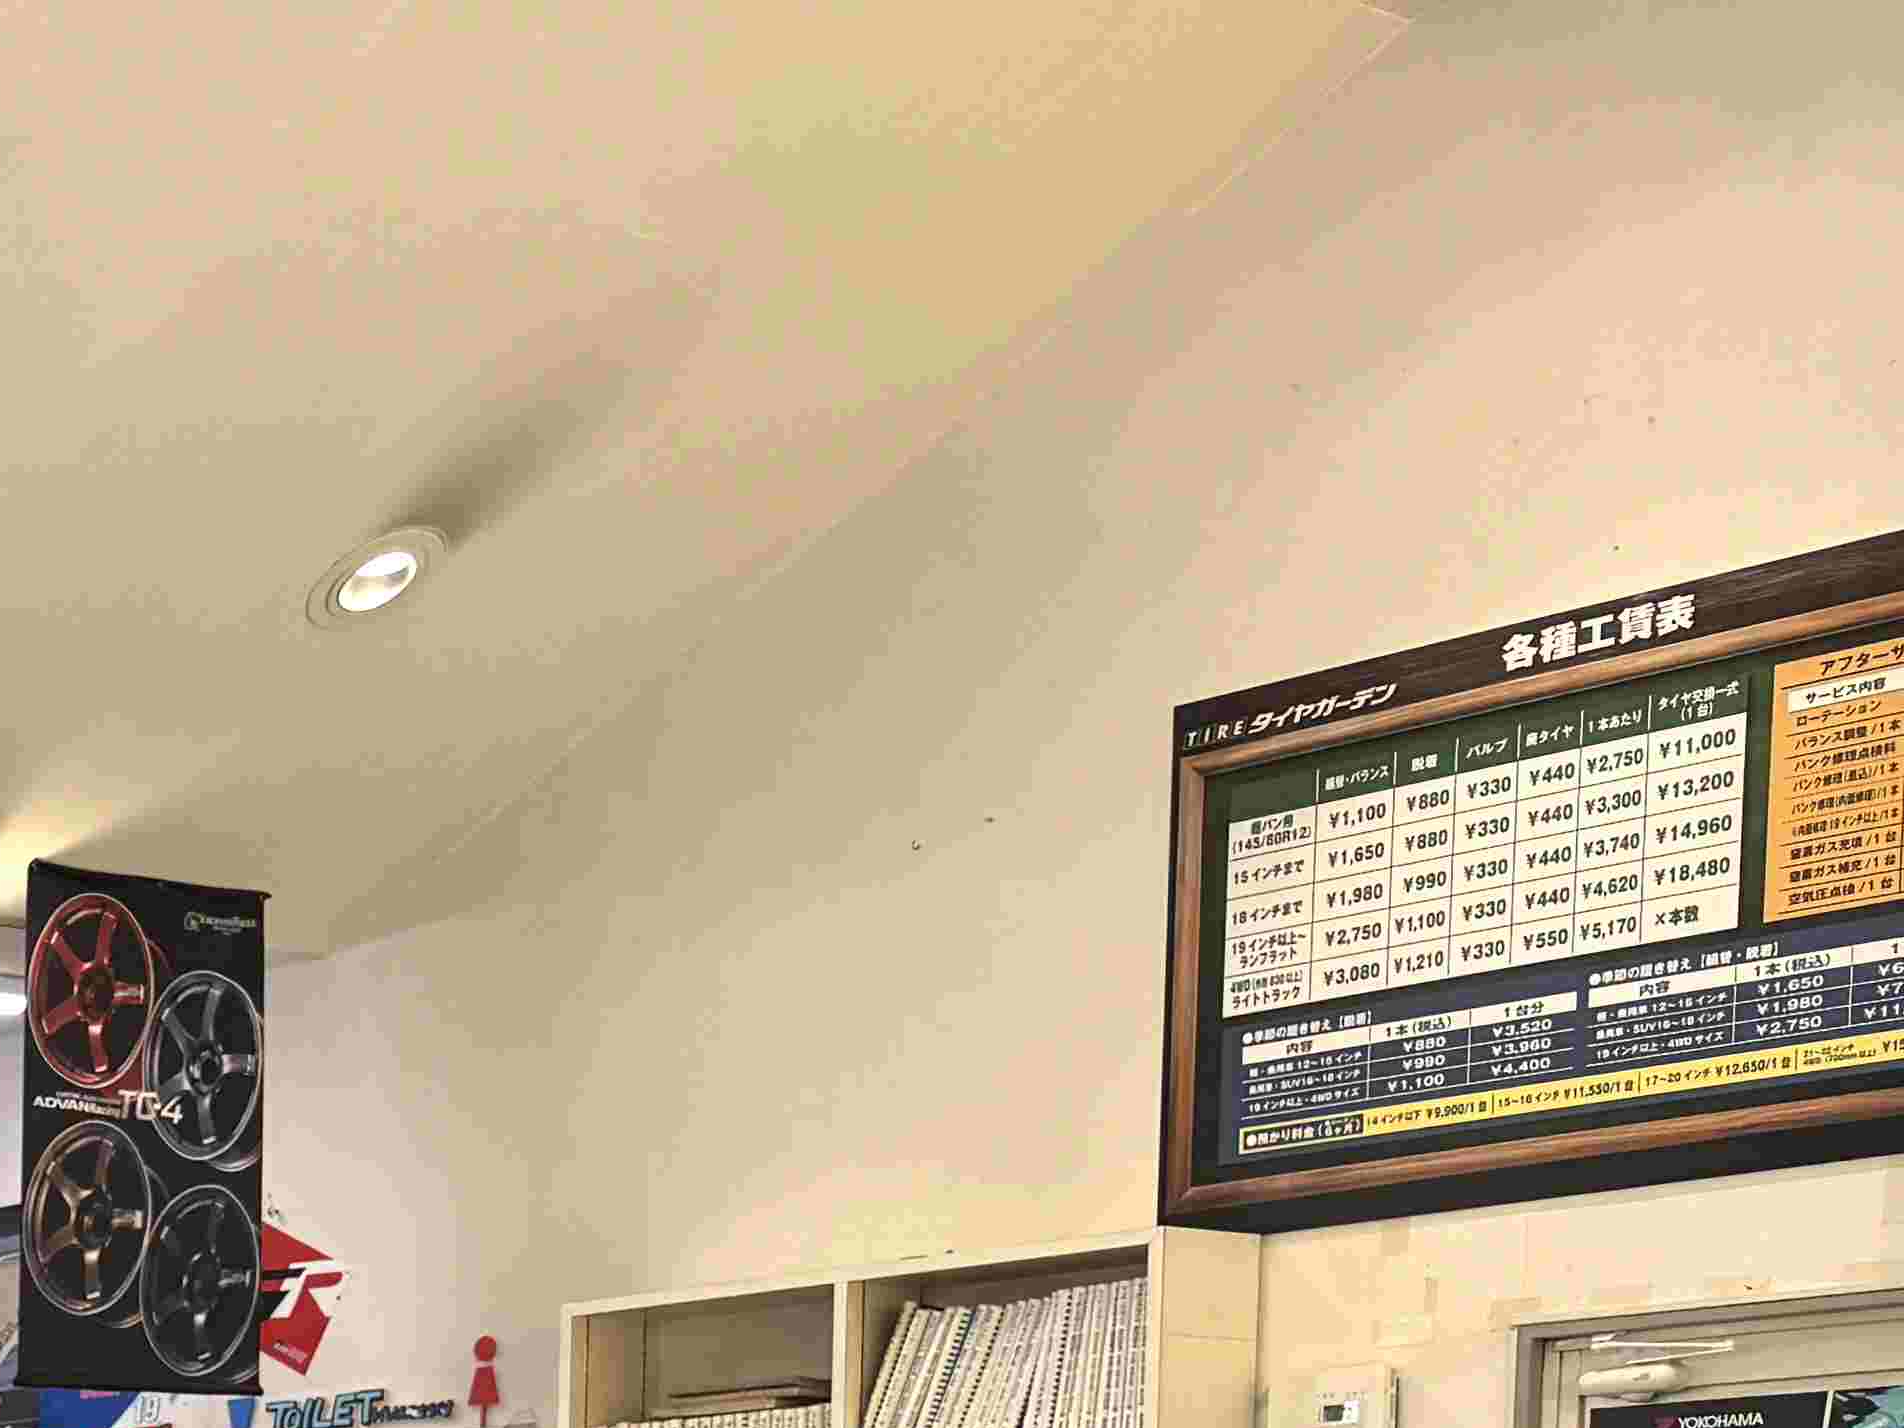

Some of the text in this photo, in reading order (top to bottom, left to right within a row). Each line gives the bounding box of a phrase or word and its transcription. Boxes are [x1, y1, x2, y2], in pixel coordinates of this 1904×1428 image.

[1500, 592, 1697, 673] 各種工賃表
[1185, 683, 1398, 748] TIRE タイヤガーデン
[1804, 676, 1888, 705] サービス内容
